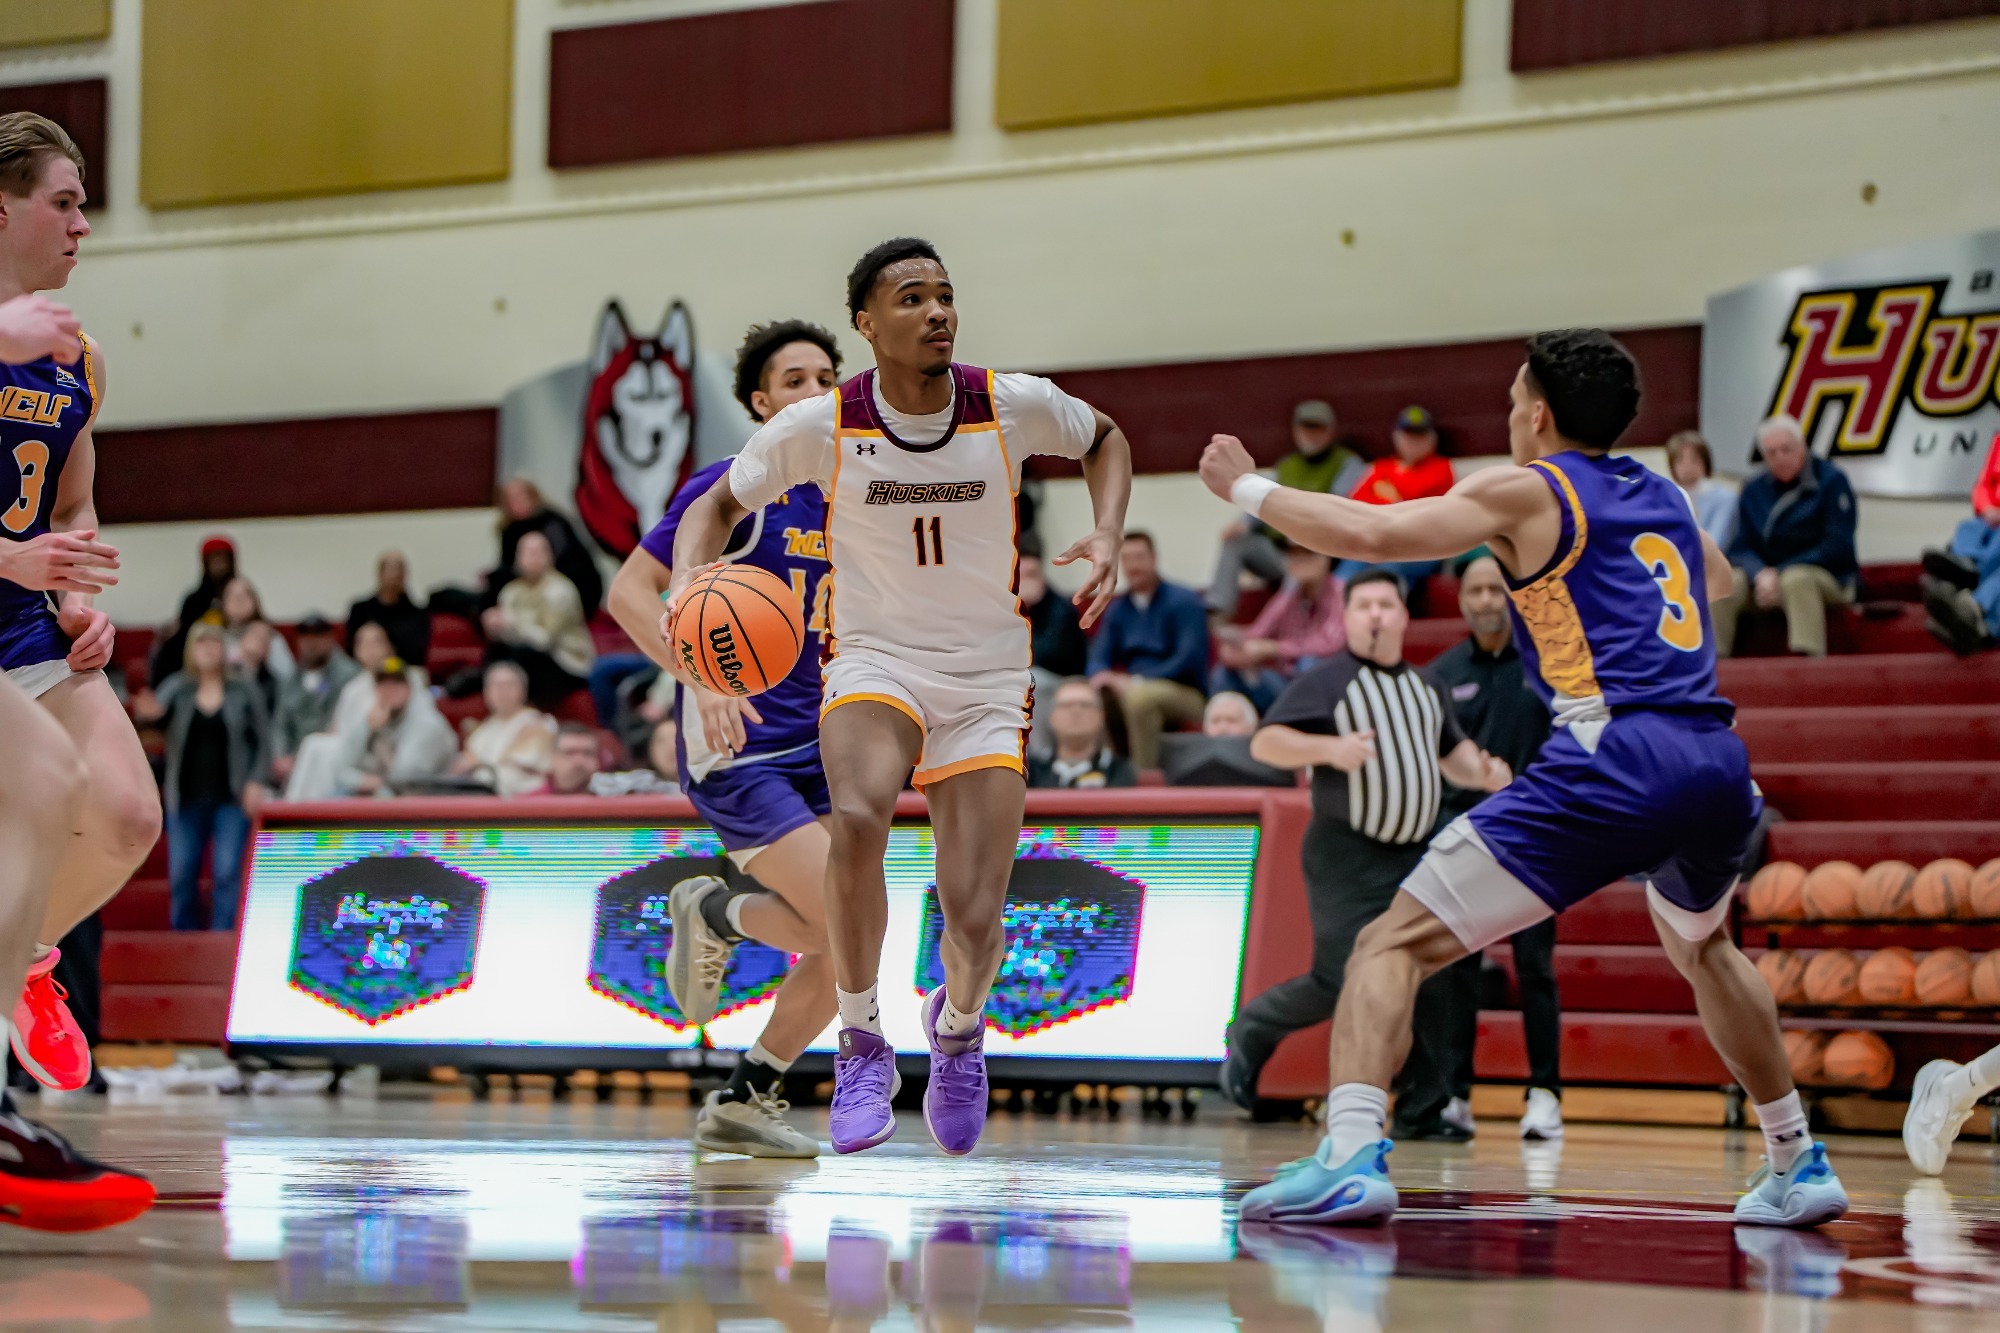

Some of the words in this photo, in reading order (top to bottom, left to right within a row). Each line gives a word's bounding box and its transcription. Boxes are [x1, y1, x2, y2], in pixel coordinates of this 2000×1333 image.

[1752, 277, 2000, 462] HU
[864, 480, 986, 505] HUSKIES
[912, 515, 945, 568] 11
[1630, 531, 1703, 653] 3
[708, 622, 751, 696] Wilson
